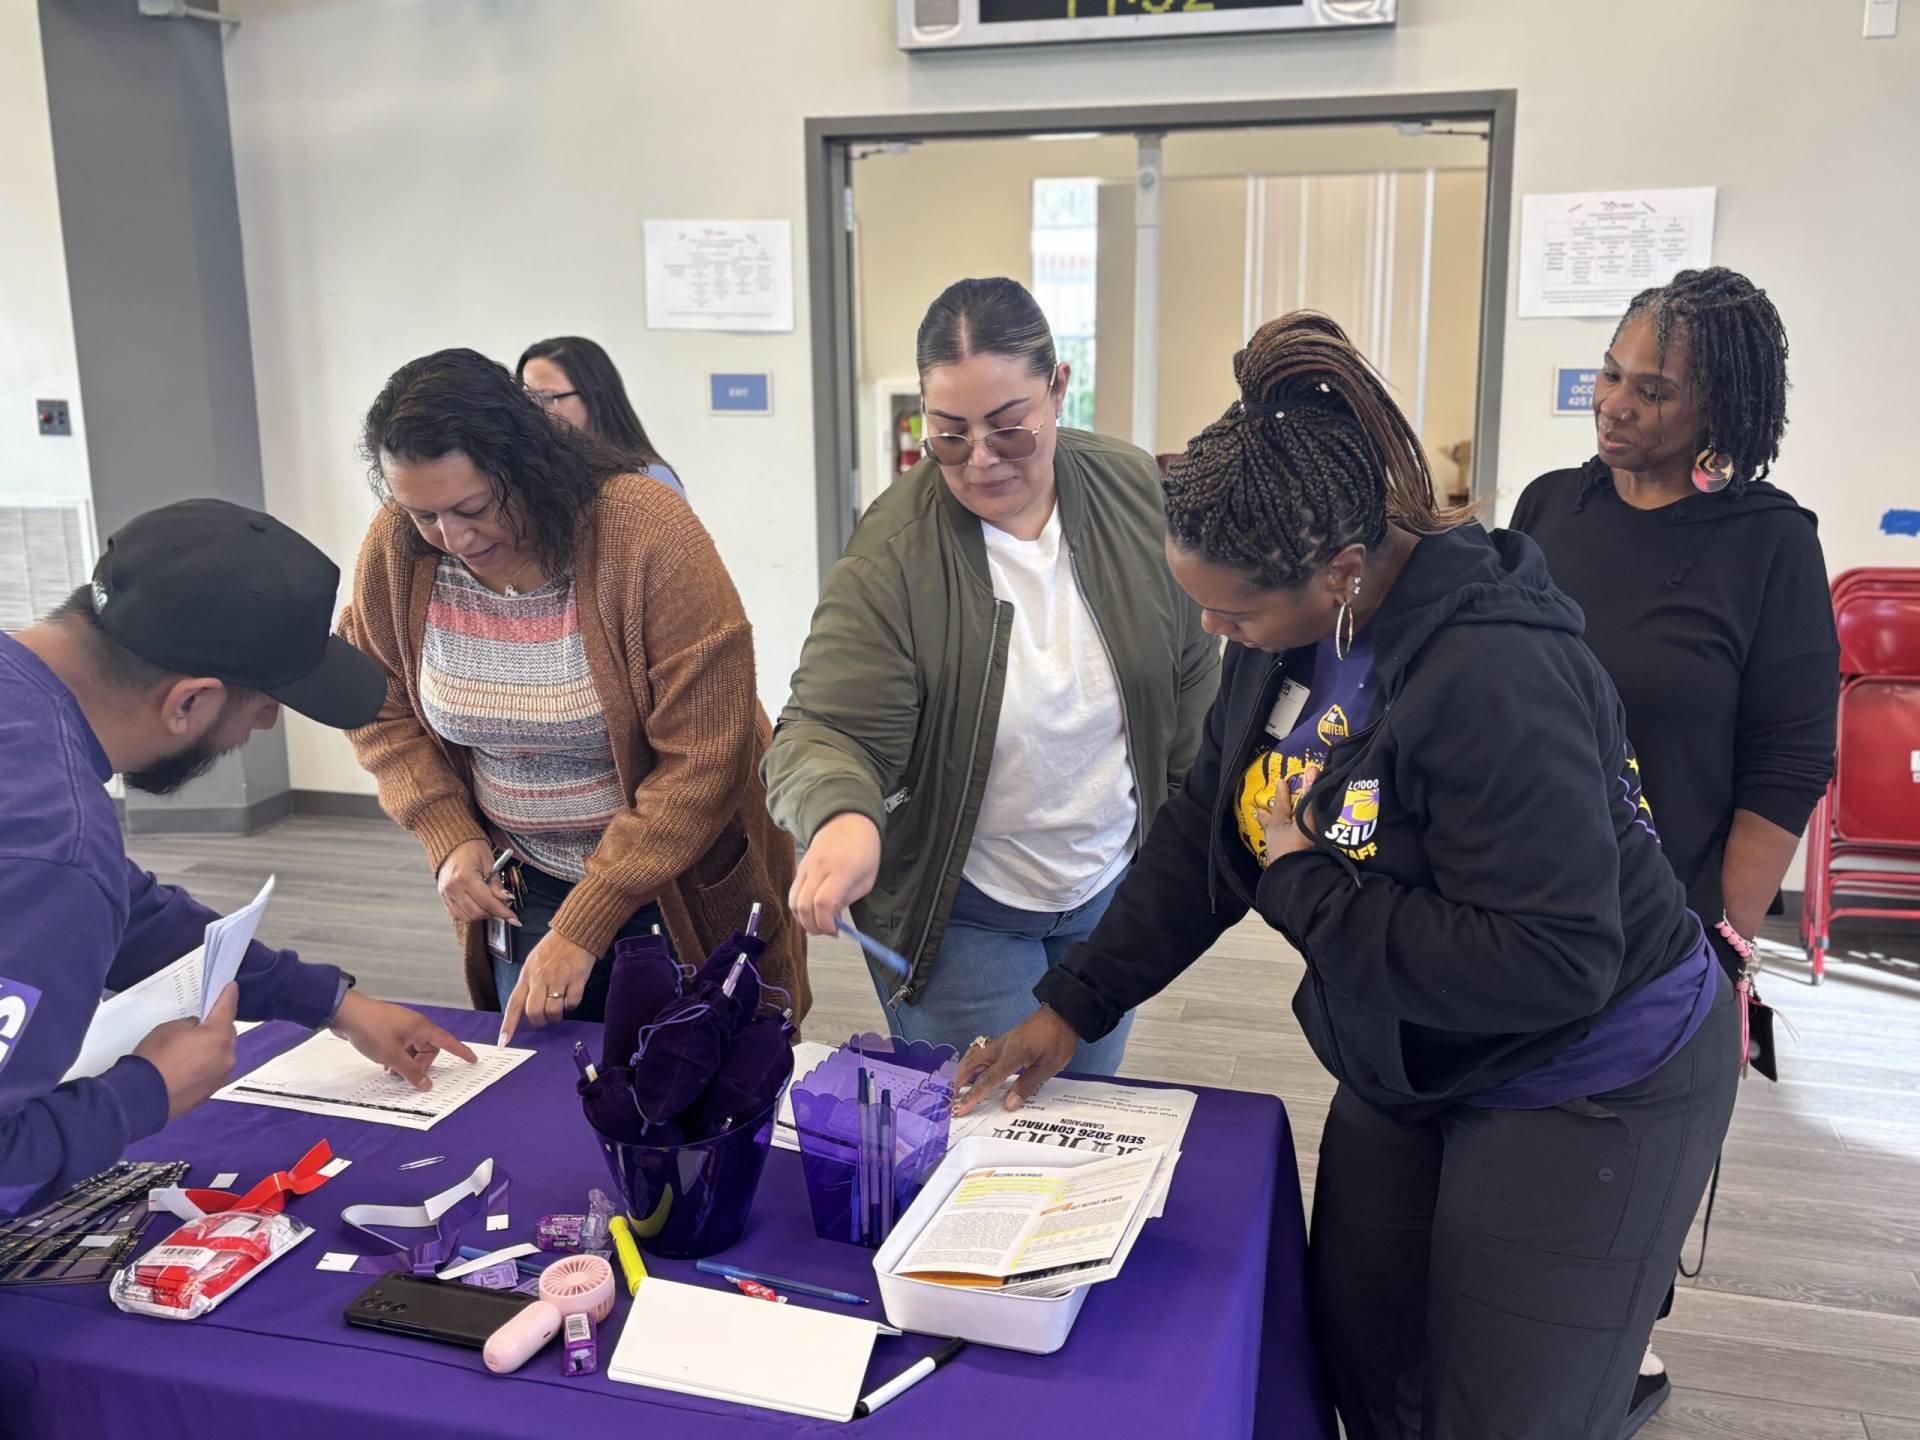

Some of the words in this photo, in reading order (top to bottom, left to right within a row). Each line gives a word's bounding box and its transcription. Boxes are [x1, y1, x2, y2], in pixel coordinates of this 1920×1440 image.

[1579, 374, 1597, 383] MA
[728, 387, 748, 397] EXIT
[1571, 385, 1595, 395] OCC
[1568, 397, 1587, 406] 425
[1324, 818, 1377, 845] SEIU
[1010, 1118, 1075, 1135] CONTRACT
[1060, 1118, 1105, 1130] CAMPAIGN
[1077, 1129, 1114, 1141] 2026
[1116, 1133, 1146, 1145] SEIU
